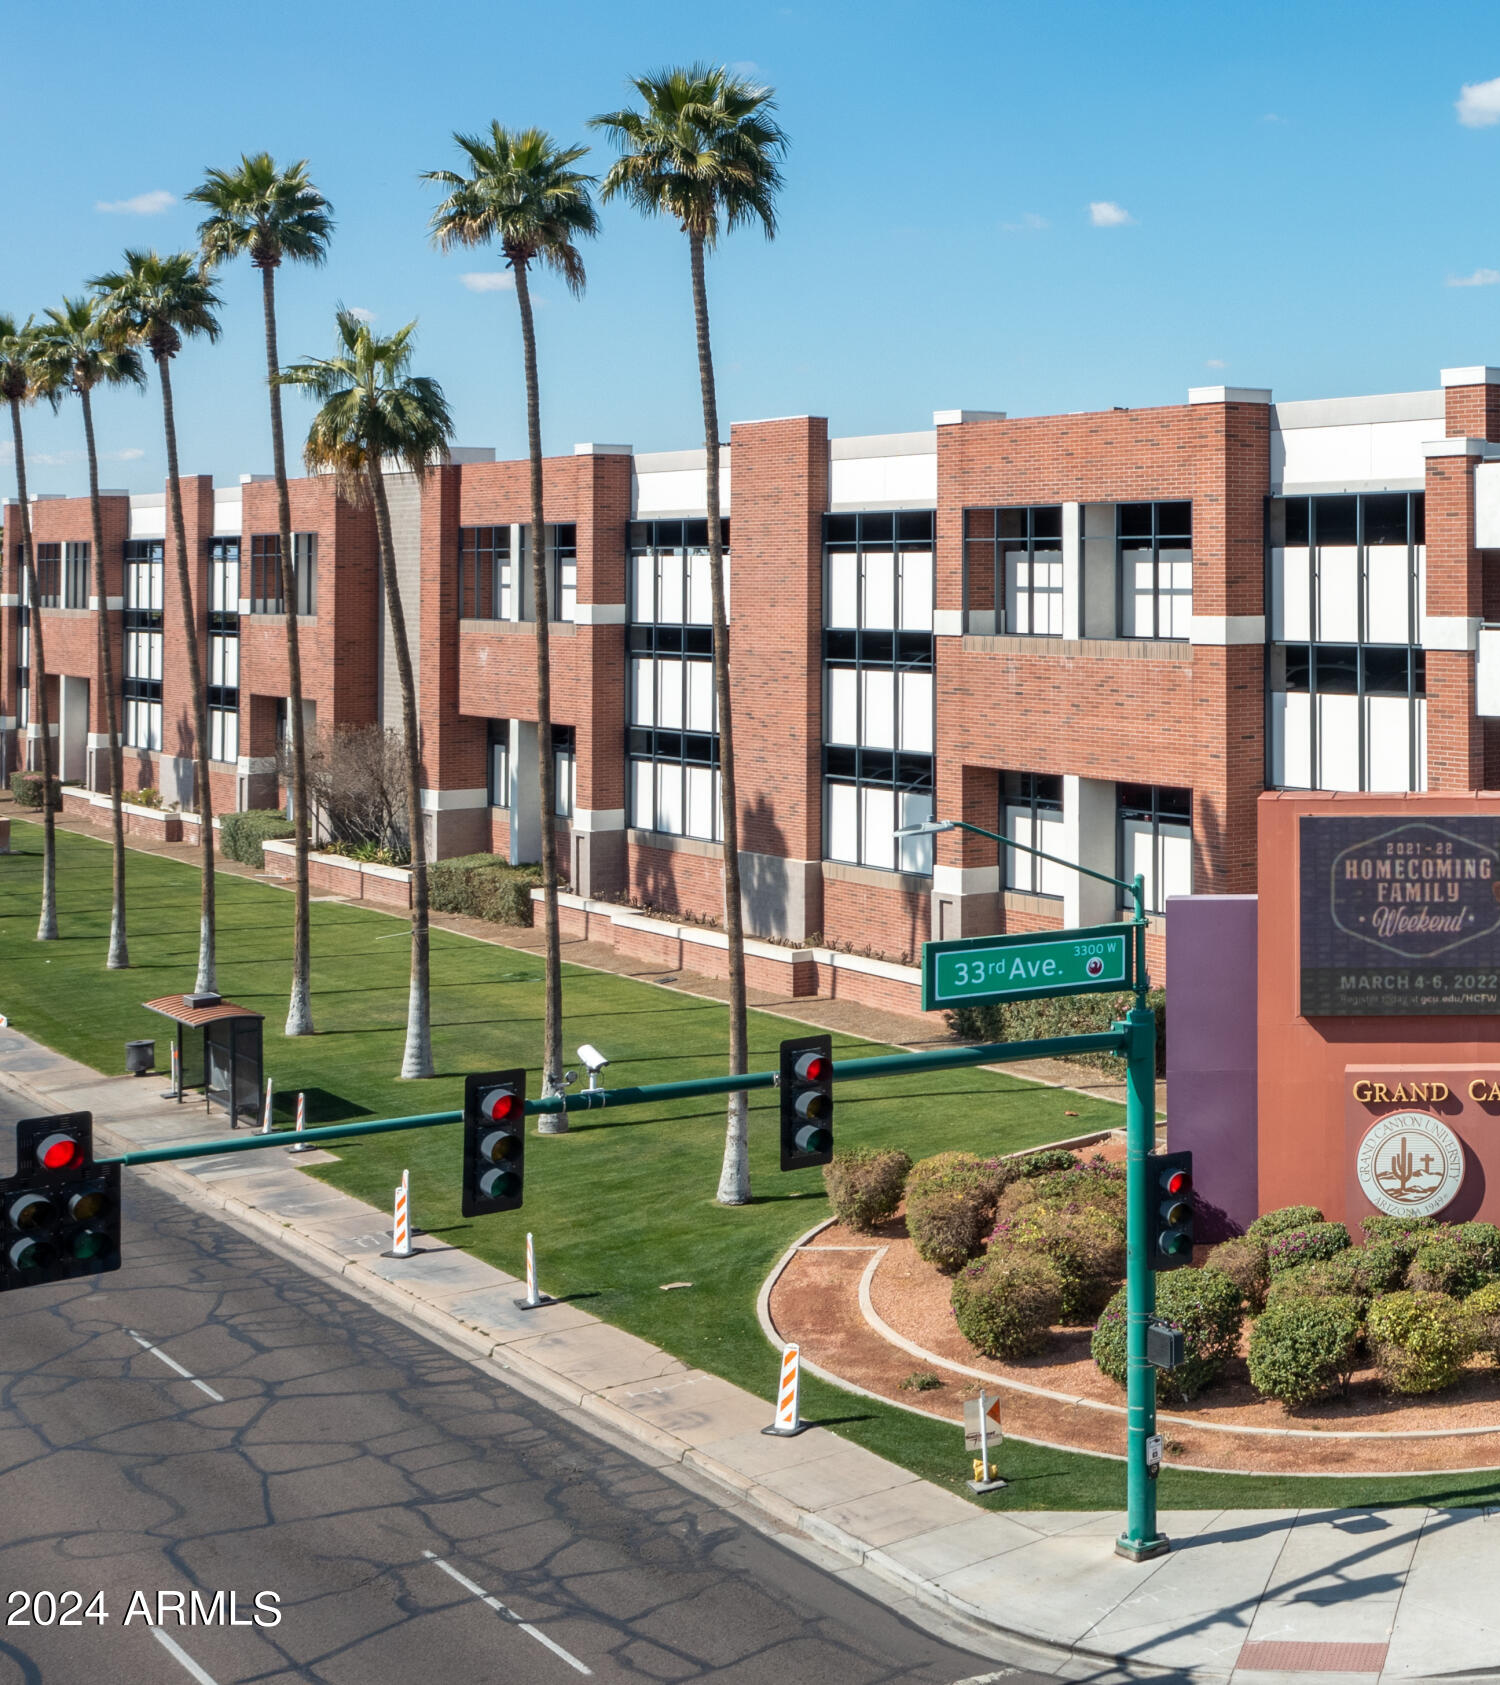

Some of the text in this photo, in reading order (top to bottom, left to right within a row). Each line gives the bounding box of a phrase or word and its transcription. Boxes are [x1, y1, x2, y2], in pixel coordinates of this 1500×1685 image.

[1345, 858, 1492, 880] HOMECOMING
[1377, 882, 1460, 902] FAMILY
[1372, 905, 1467, 937] Weekend
[1073, 942, 1117, 957] 3300 W
[954, 957, 1064, 986] 33rd Ave.
[1340, 974, 1498, 990] MARCH 4-6, 2022
[1420, 993, 1497, 1005] gcu.edu/HCFW
[1352, 1080, 1449, 1103] GRAND
[1360, 1115, 1461, 1183] GRAND CANYON UNIVERSITY
[1373, 1196, 1421, 1217] ARIZONA
